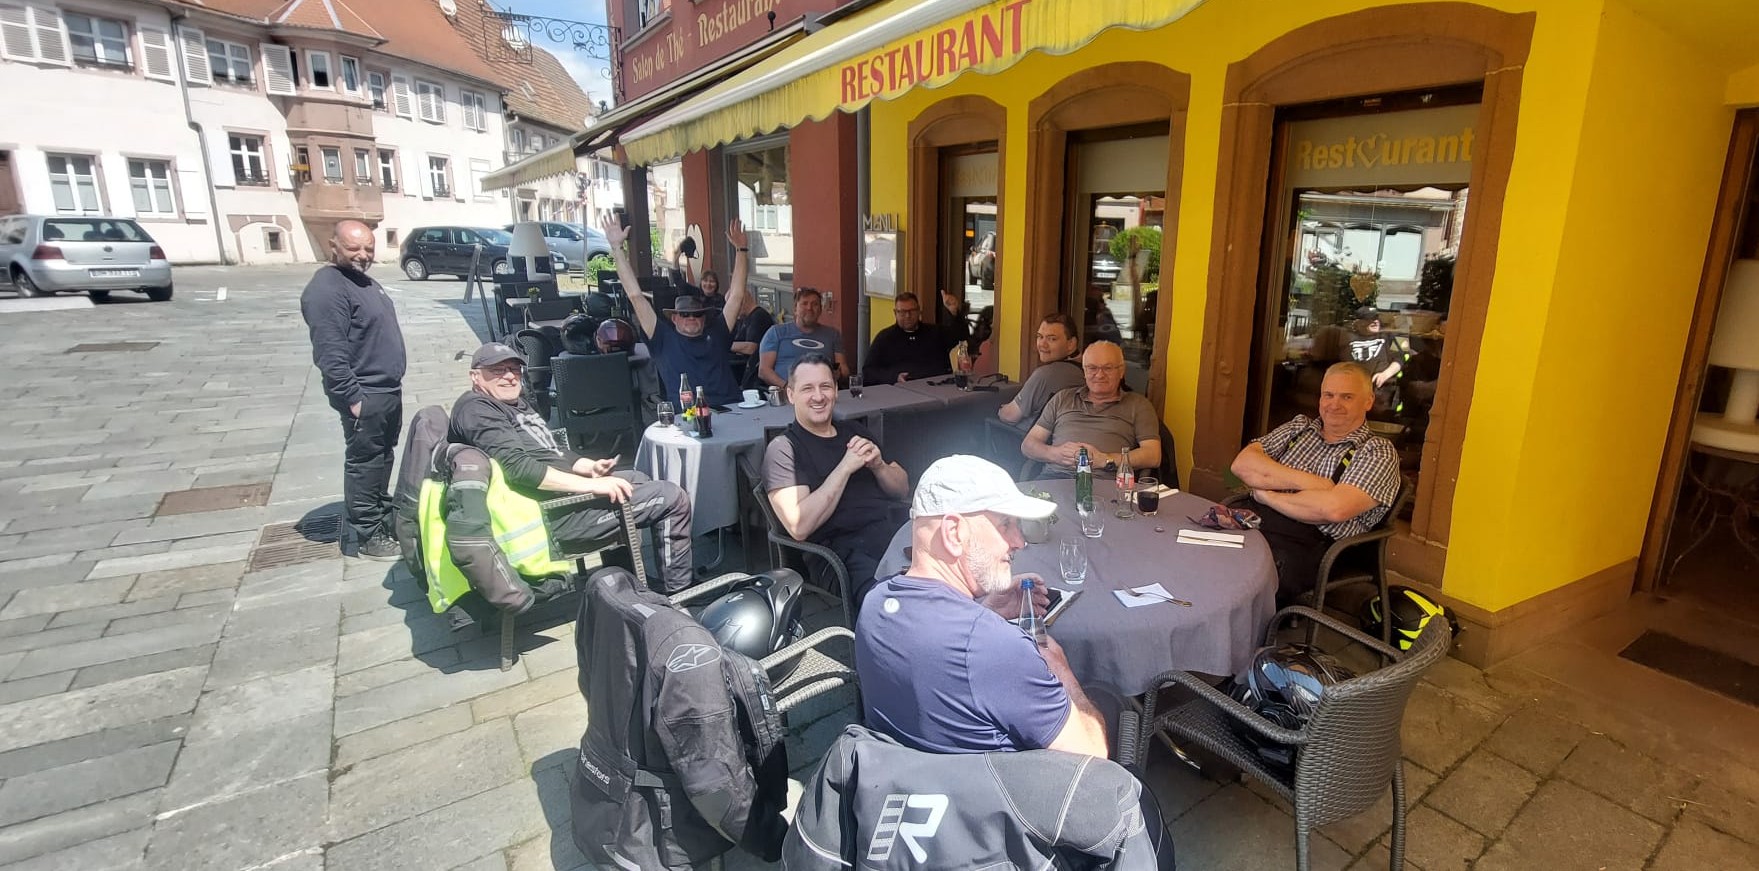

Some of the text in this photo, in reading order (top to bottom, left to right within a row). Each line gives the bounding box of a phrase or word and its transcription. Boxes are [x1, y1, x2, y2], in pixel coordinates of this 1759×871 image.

[632, 53, 653, 84] Salon
[655, 43, 665, 71] de
[667, 27, 685, 67] Thé
[841, 0, 1032, 104] RESTAURANT
